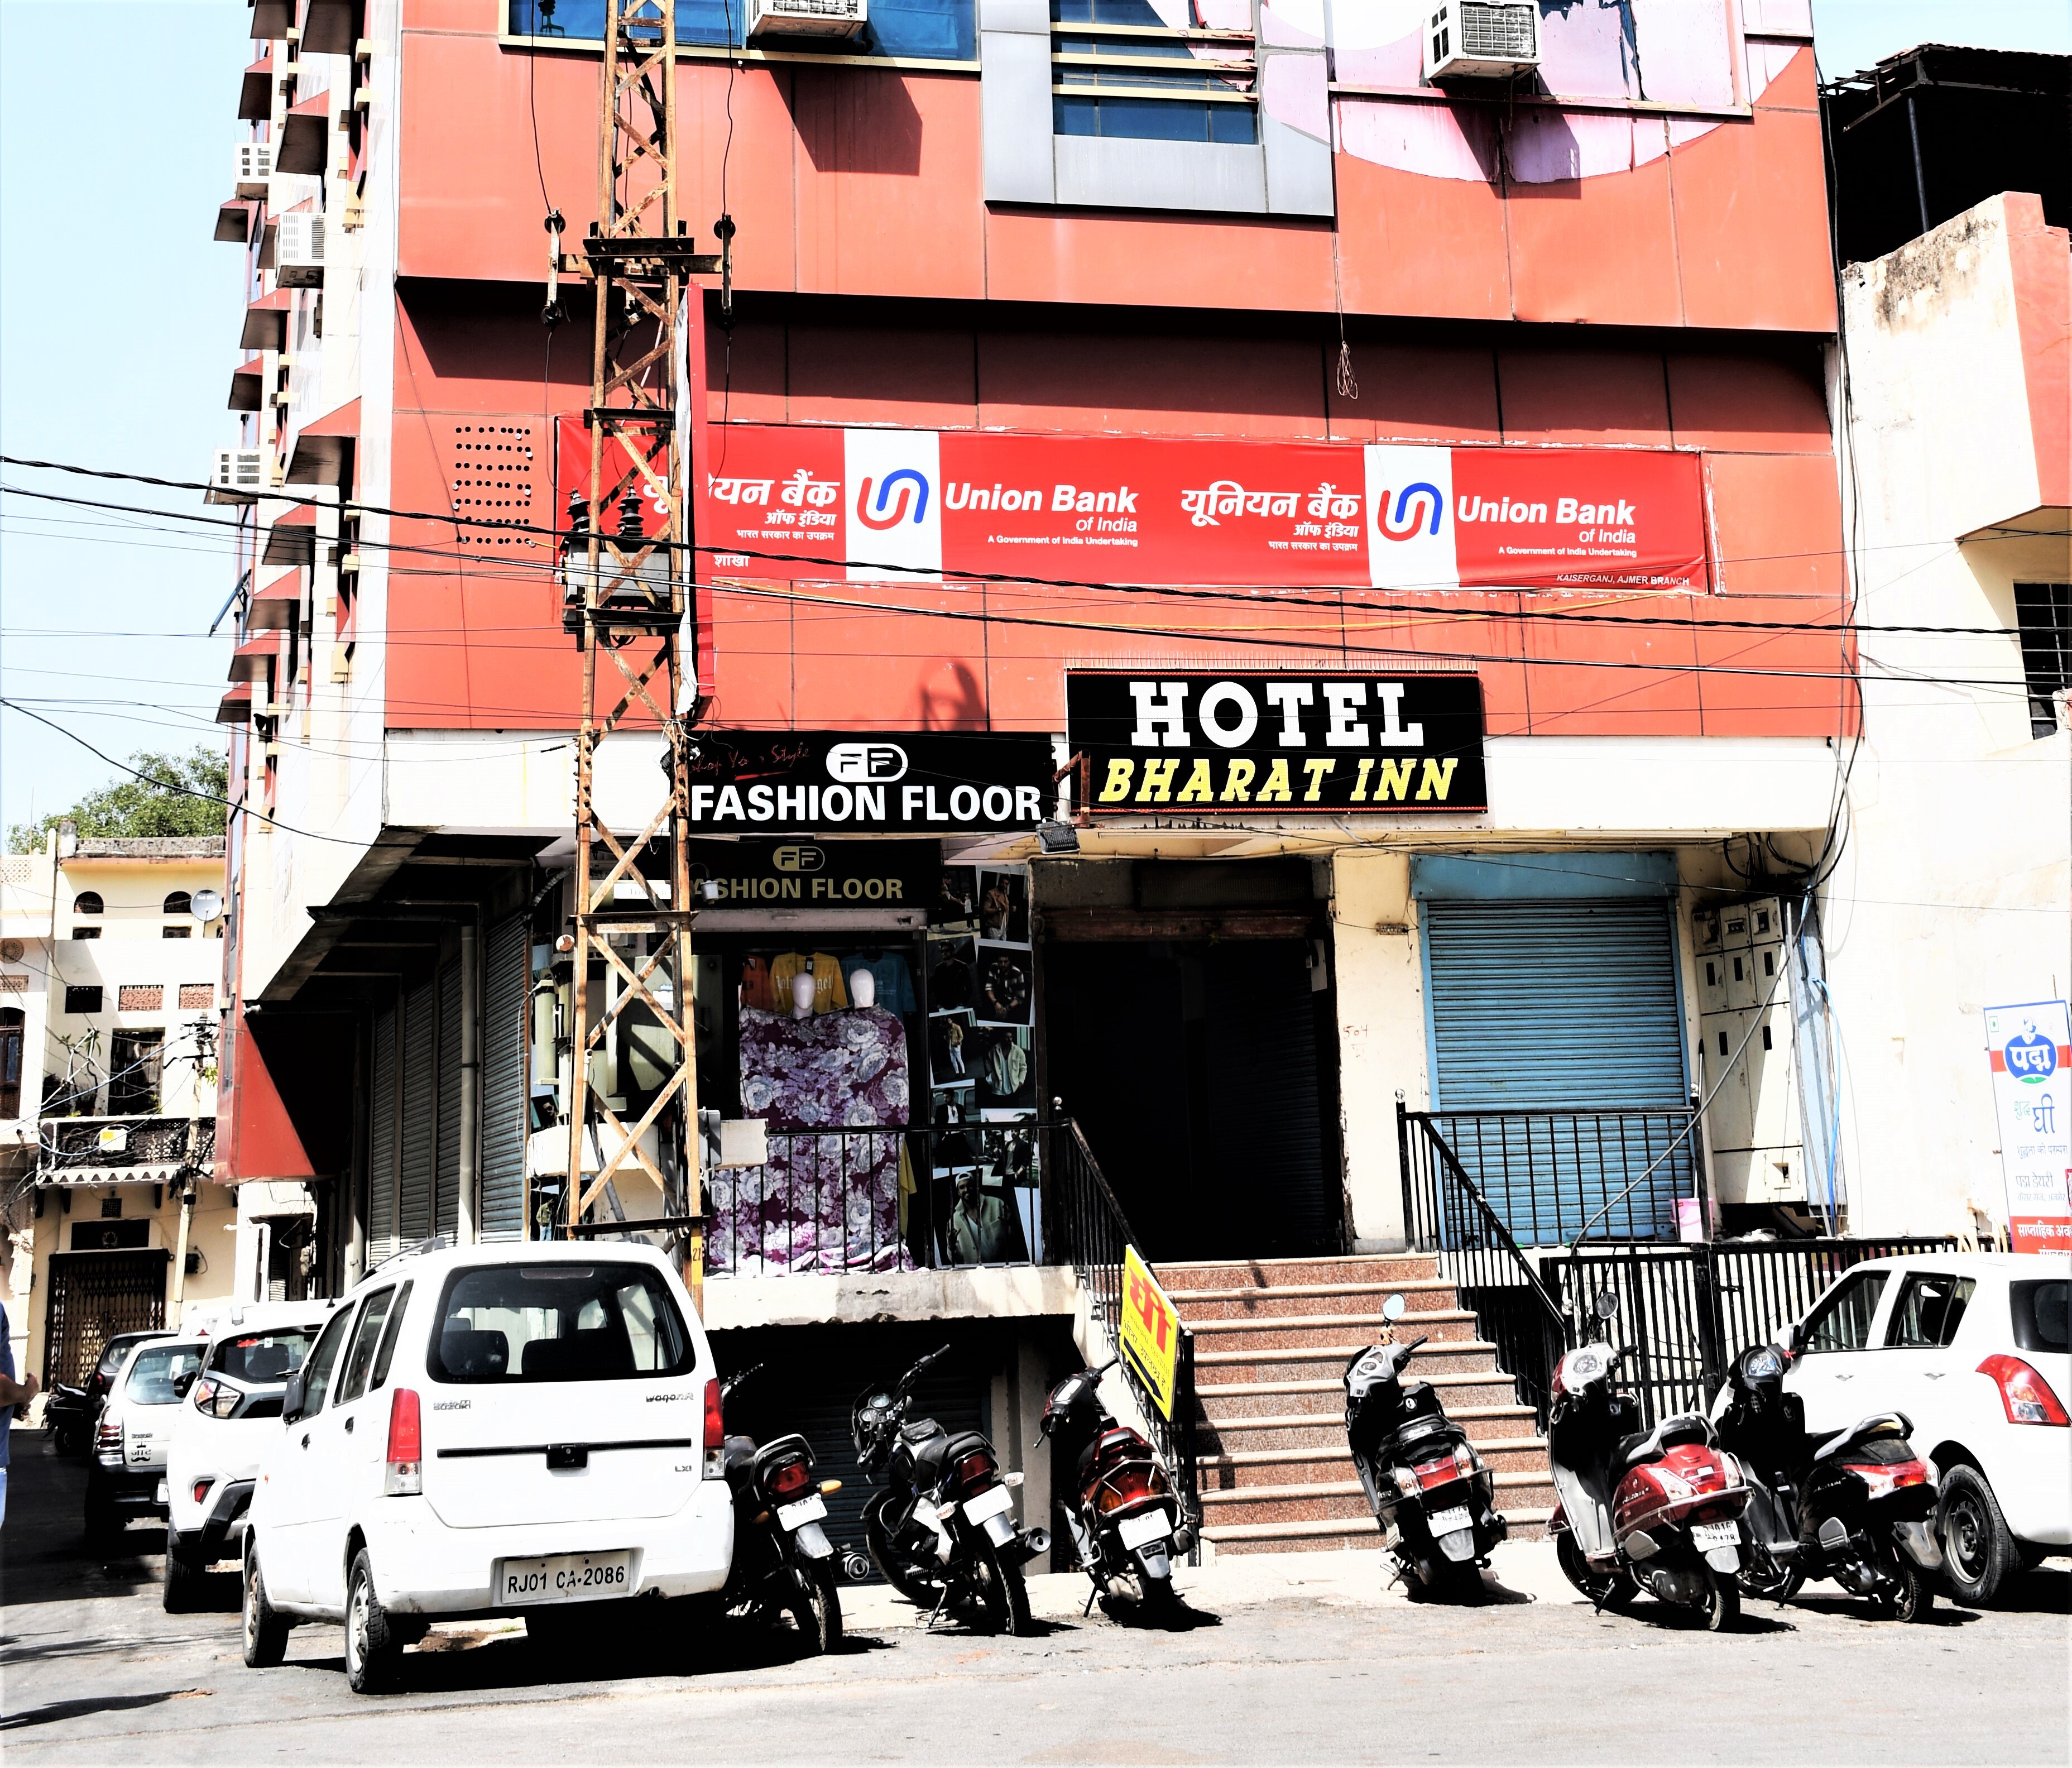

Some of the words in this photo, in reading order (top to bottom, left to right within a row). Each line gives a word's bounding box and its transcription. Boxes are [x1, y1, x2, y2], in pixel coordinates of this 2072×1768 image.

[781, 468, 841, 507] बैंक
[946, 482, 1043, 511] Union
[1051, 485, 1138, 513] Bank
[1181, 480, 1299, 526] यूनियन
[1307, 482, 1361, 520] बैंक
[1457, 495, 1548, 523] Union
[1555, 497, 1636, 525] Bank
[764, 509, 797, 525] ऑफ
[798, 510, 837, 528] इंडिया
[1076, 516, 1094, 531] of
[1097, 516, 1138, 532] India
[736, 529, 759, 538] भारत
[761, 530, 790, 539] सरकार
[792, 531, 804, 540] का
[806, 531, 834, 540] उपक्रम
[1293, 521, 1323, 536] ऑफ
[1324, 522, 1360, 539] इंडिया
[1579, 528, 1595, 543] of
[1599, 529, 1636, 544] India
[987, 535, 995, 543] A
[996, 535, 1050, 544] Government
[1062, 536, 1083, 545] India
[1085, 536, 1138, 547] Undertaking
[1268, 541, 1289, 549] भारत
[1290, 542, 1317, 550] सरकार
[1319, 543, 1331, 551] का
[1332, 543, 1358, 552] उपक्रम
[713, 554, 751, 568] शाखा
[1506, 546, 1556, 555] Government
[1567, 547, 1586, 555] India
[1588, 548, 1637, 558] Undertaking
[1556, 574, 1615, 584] KAISERGANJ,
[1617, 576, 1649, 584] AJMER
[1651, 576, 1690, 586] BRANCH
[1129, 681, 1424, 748] HOTEL
[1098, 758, 1336, 802] BHARAT
[1349, 758, 1459, 801] INN
[691, 784, 885, 821] FASHION
[902, 784, 1042, 821] FLOOR
[694, 878, 801, 900] ASHION
[812, 878, 903, 899] FLOOR
[2032, 1093, 2056, 1134] घी
[2016, 1219, 2055, 1239] साप्ताहिक
[693, 1247, 702, 1261] 21
[1129, 1266, 1172, 1355] घी
[507, 1571, 547, 1594] RJ01
